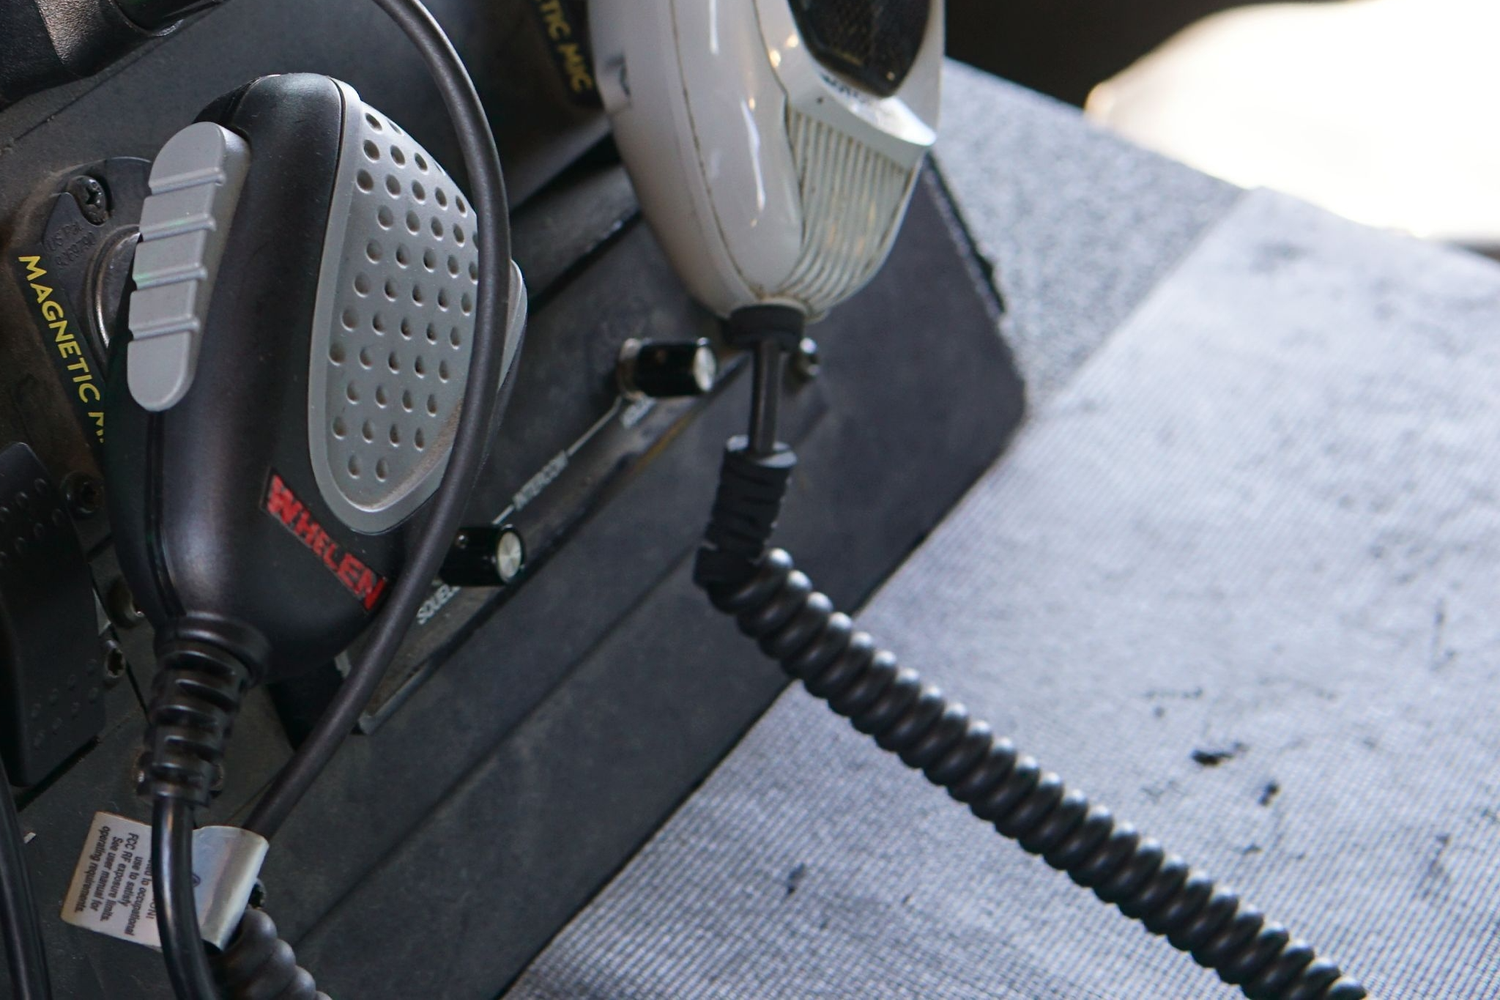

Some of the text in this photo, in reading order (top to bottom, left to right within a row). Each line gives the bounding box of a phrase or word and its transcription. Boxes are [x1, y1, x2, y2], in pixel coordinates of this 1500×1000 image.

[557, 42, 594, 93] MIC
[18, 254, 101, 404] MAGNETIC
[267, 473, 389, 611] WHELEN
[89, 825, 111, 863] operating
[120, 850, 133, 863] RF
[125, 832, 139, 851] FCC
[131, 856, 144, 871] use
[89, 836, 124, 913] See user manual for
[107, 863, 127, 899] exposure
[124, 886, 147, 936] occupational
